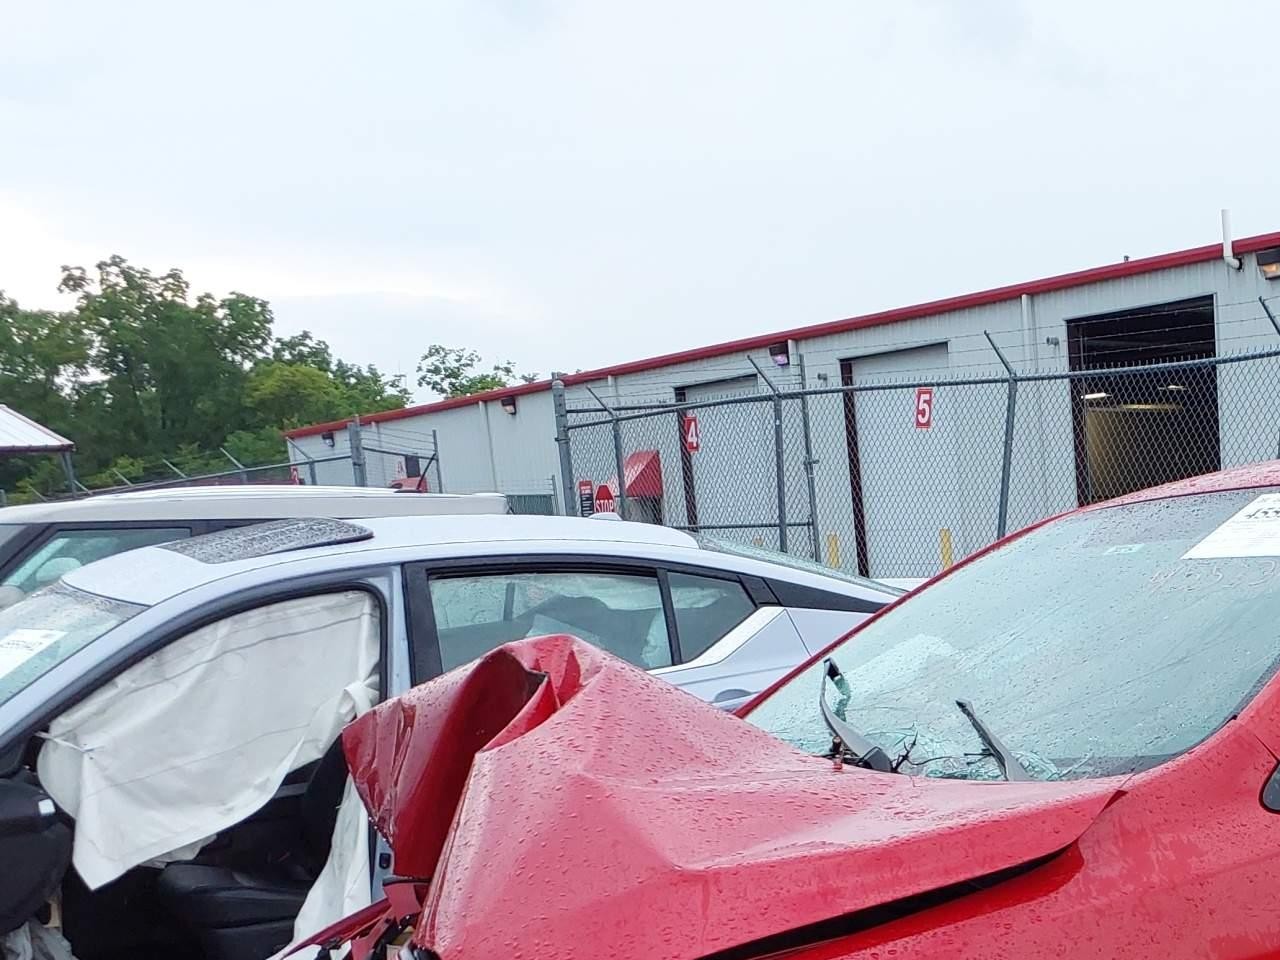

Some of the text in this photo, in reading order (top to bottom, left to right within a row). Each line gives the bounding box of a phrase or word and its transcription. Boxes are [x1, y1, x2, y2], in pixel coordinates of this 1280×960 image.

[918, 393, 930, 424] 5
[687, 421, 698, 447] 4
[596, 499, 614, 512] STOP
